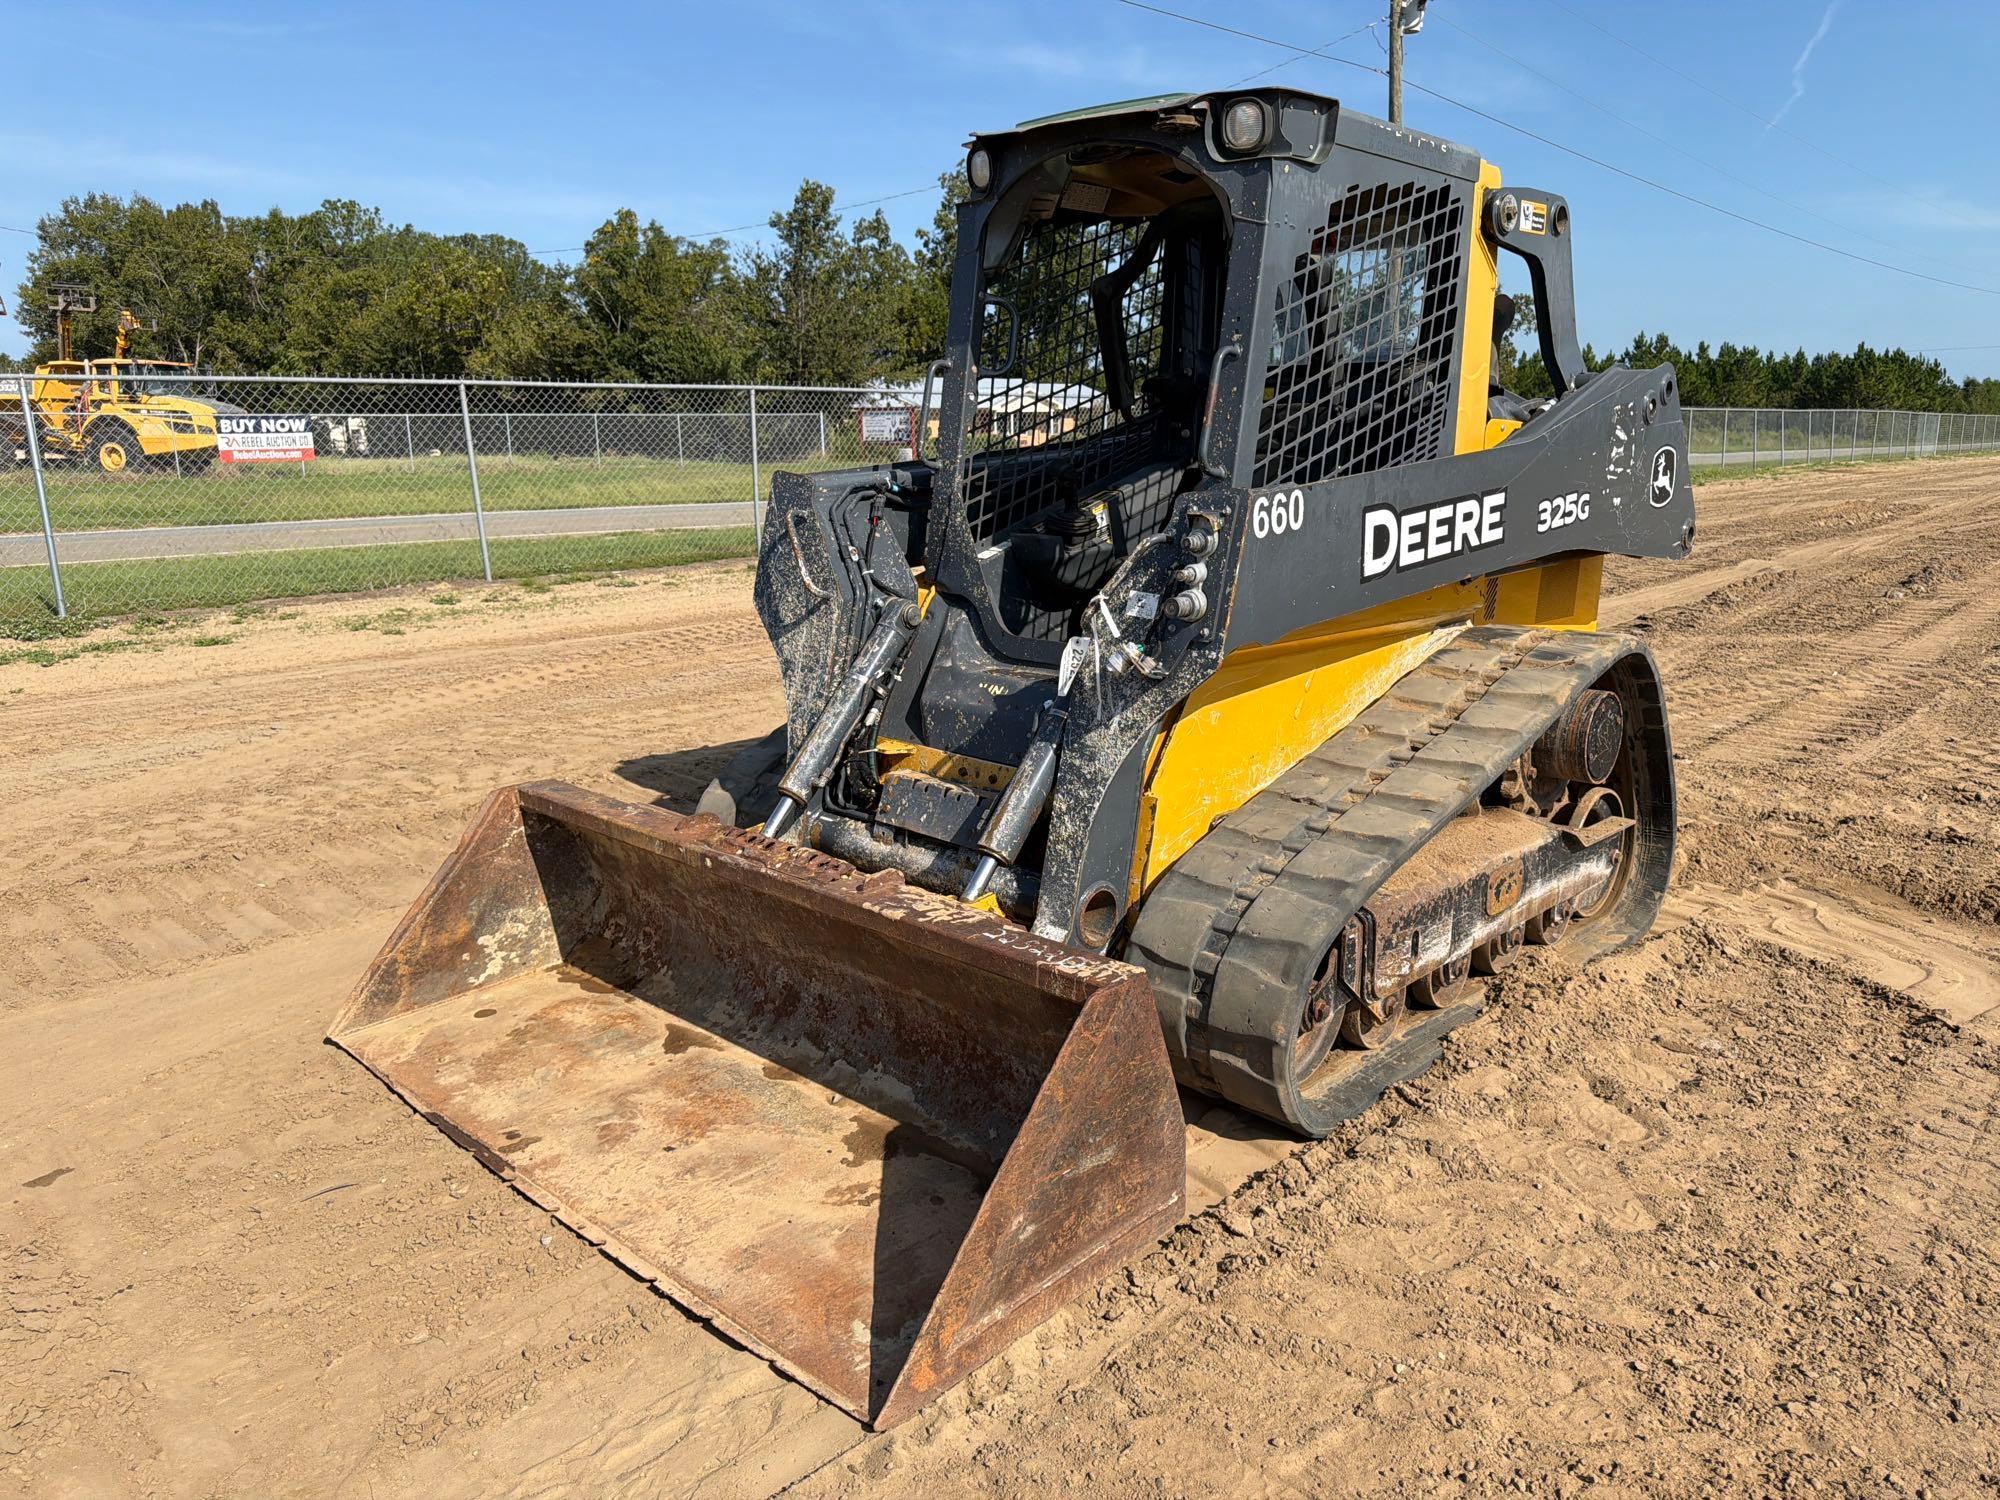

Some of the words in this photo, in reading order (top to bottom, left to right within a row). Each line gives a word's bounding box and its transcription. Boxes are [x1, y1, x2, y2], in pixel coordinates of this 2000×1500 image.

[220, 418, 257, 433] BUY
[261, 418, 306, 433] NOW
[241, 436, 264, 447] REBEL
[266, 435, 297, 447] AUCTION
[1252, 488, 1304, 539] 660
[1537, 492, 1591, 534] 325G
[1362, 491, 1507, 578] DEERE
